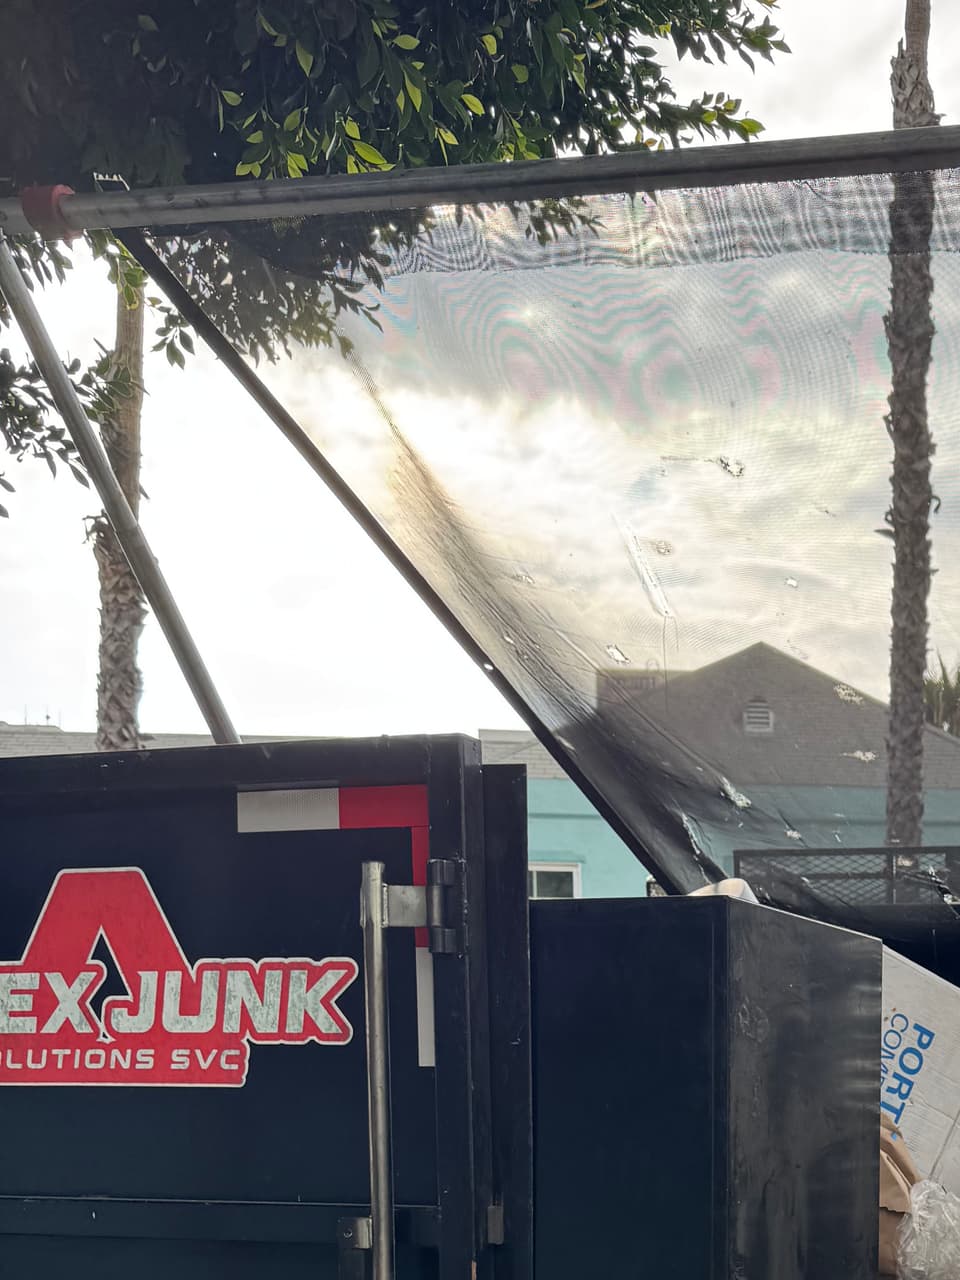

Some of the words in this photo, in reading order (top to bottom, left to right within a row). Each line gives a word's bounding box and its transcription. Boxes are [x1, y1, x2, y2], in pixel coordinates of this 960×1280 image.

[109, 968, 349, 1034] JUNK
[0, 1048, 154, 1070] LUTIONS
[170, 1049, 241, 1071] SVC
[880, 1022, 936, 1125] PORT
